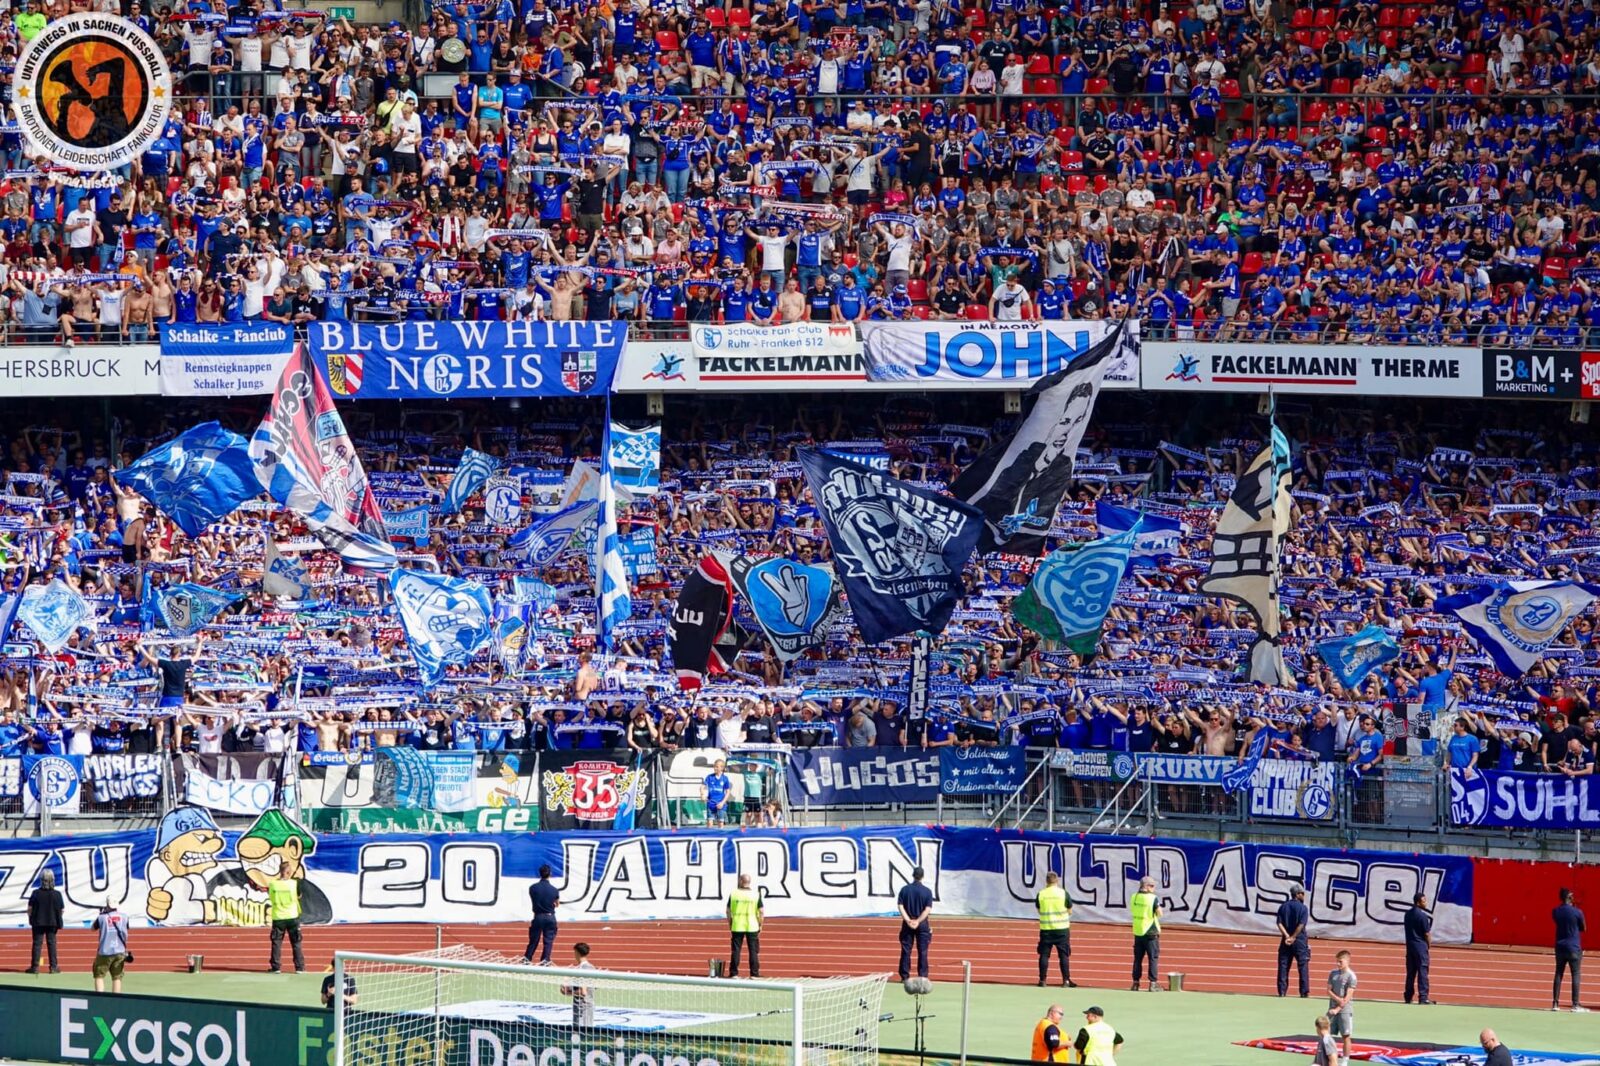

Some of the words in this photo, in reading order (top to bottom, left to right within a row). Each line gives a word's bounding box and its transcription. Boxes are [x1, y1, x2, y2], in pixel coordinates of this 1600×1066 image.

[169, 330, 218, 343] Schalke
[234, 329, 286, 343] Fanclub
[319, 321, 438, 351] BLUE
[452, 320, 616, 350] WHITE
[979, 323, 1040, 331] MEMORY
[727, 339, 750, 349] Ruhr
[761, 339, 802, 348] Franken
[805, 337, 824, 347] 512
[915, 329, 1090, 378] JOHN
[184, 361, 272, 374] Rennsteigknappen
[1212, 355, 1358, 376] FACKELMANN
[1372, 358, 1459, 379] THERME
[1496, 355, 1555, 383] B&M
[194, 379, 235, 389] Schalker
[237, 379, 264, 389] Jungs
[1496, 383, 1548, 393] MARKETING
[956, 747, 1010, 761] Solidarität
[84, 754, 162, 779] MARLER
[801, 756, 941, 795] HUGOS
[963, 767, 979, 776] mit
[981, 766, 1005, 775] allen
[1074, 764, 1112, 777] CHAOTEN
[1251, 759, 1336, 789] SUPPORTERS
[575, 772, 618, 809] 35
[1252, 788, 1298, 817] CLUB
[359, 842, 502, 908] 20
[60, 997, 250, 1066] Exasol
